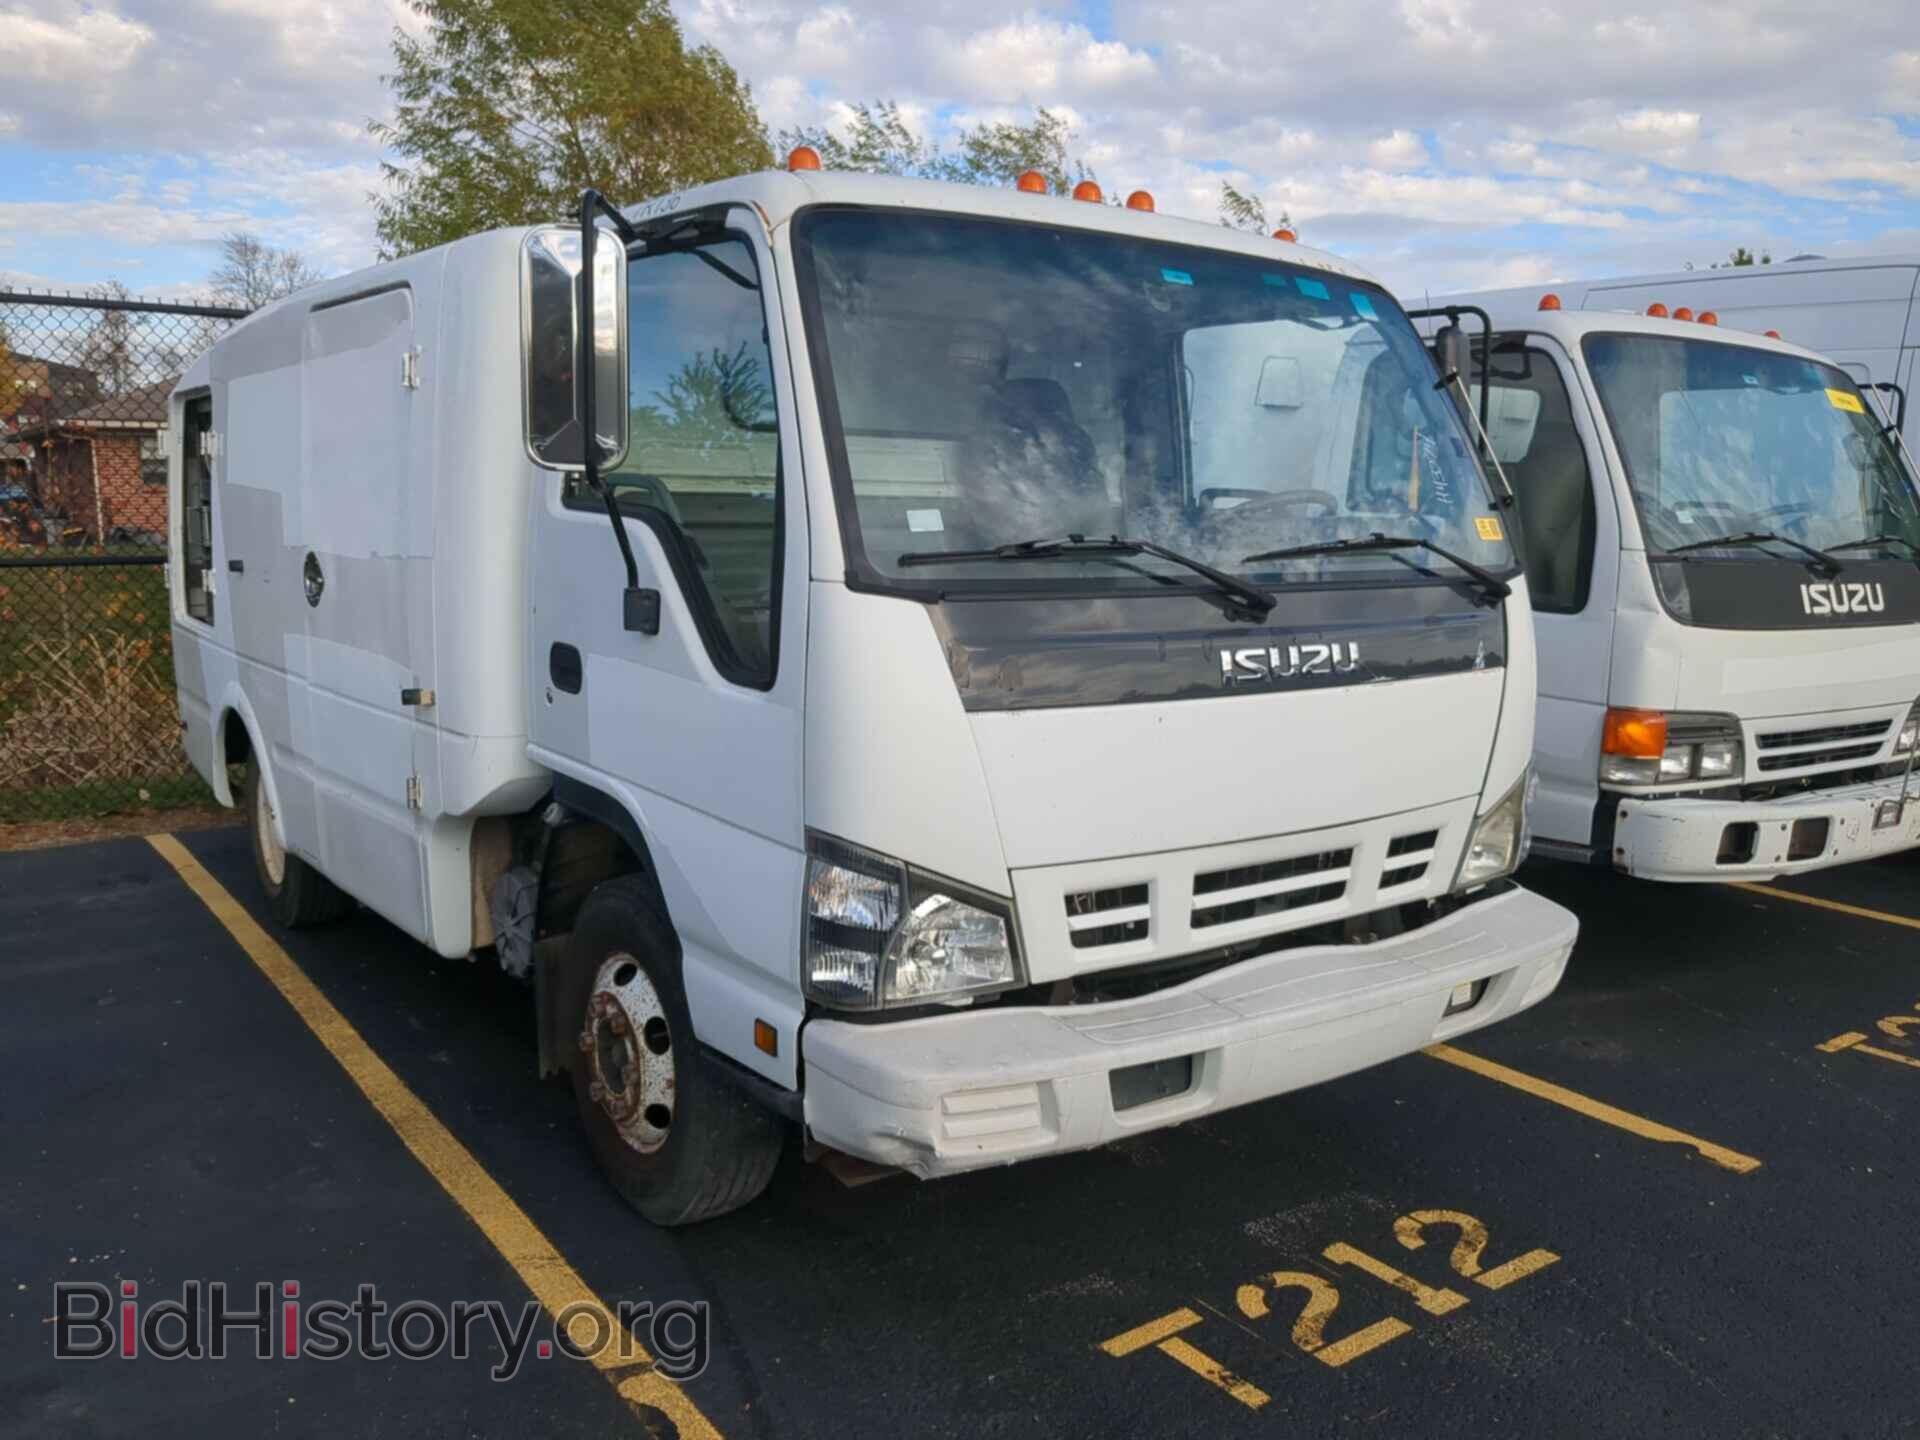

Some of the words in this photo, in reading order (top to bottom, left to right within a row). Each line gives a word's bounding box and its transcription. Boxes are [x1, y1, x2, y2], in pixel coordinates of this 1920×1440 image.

[1800, 583, 1885, 614] ISUZU
[1220, 641, 1361, 686] ISUZU
[1099, 1210, 1562, 1410] T212
